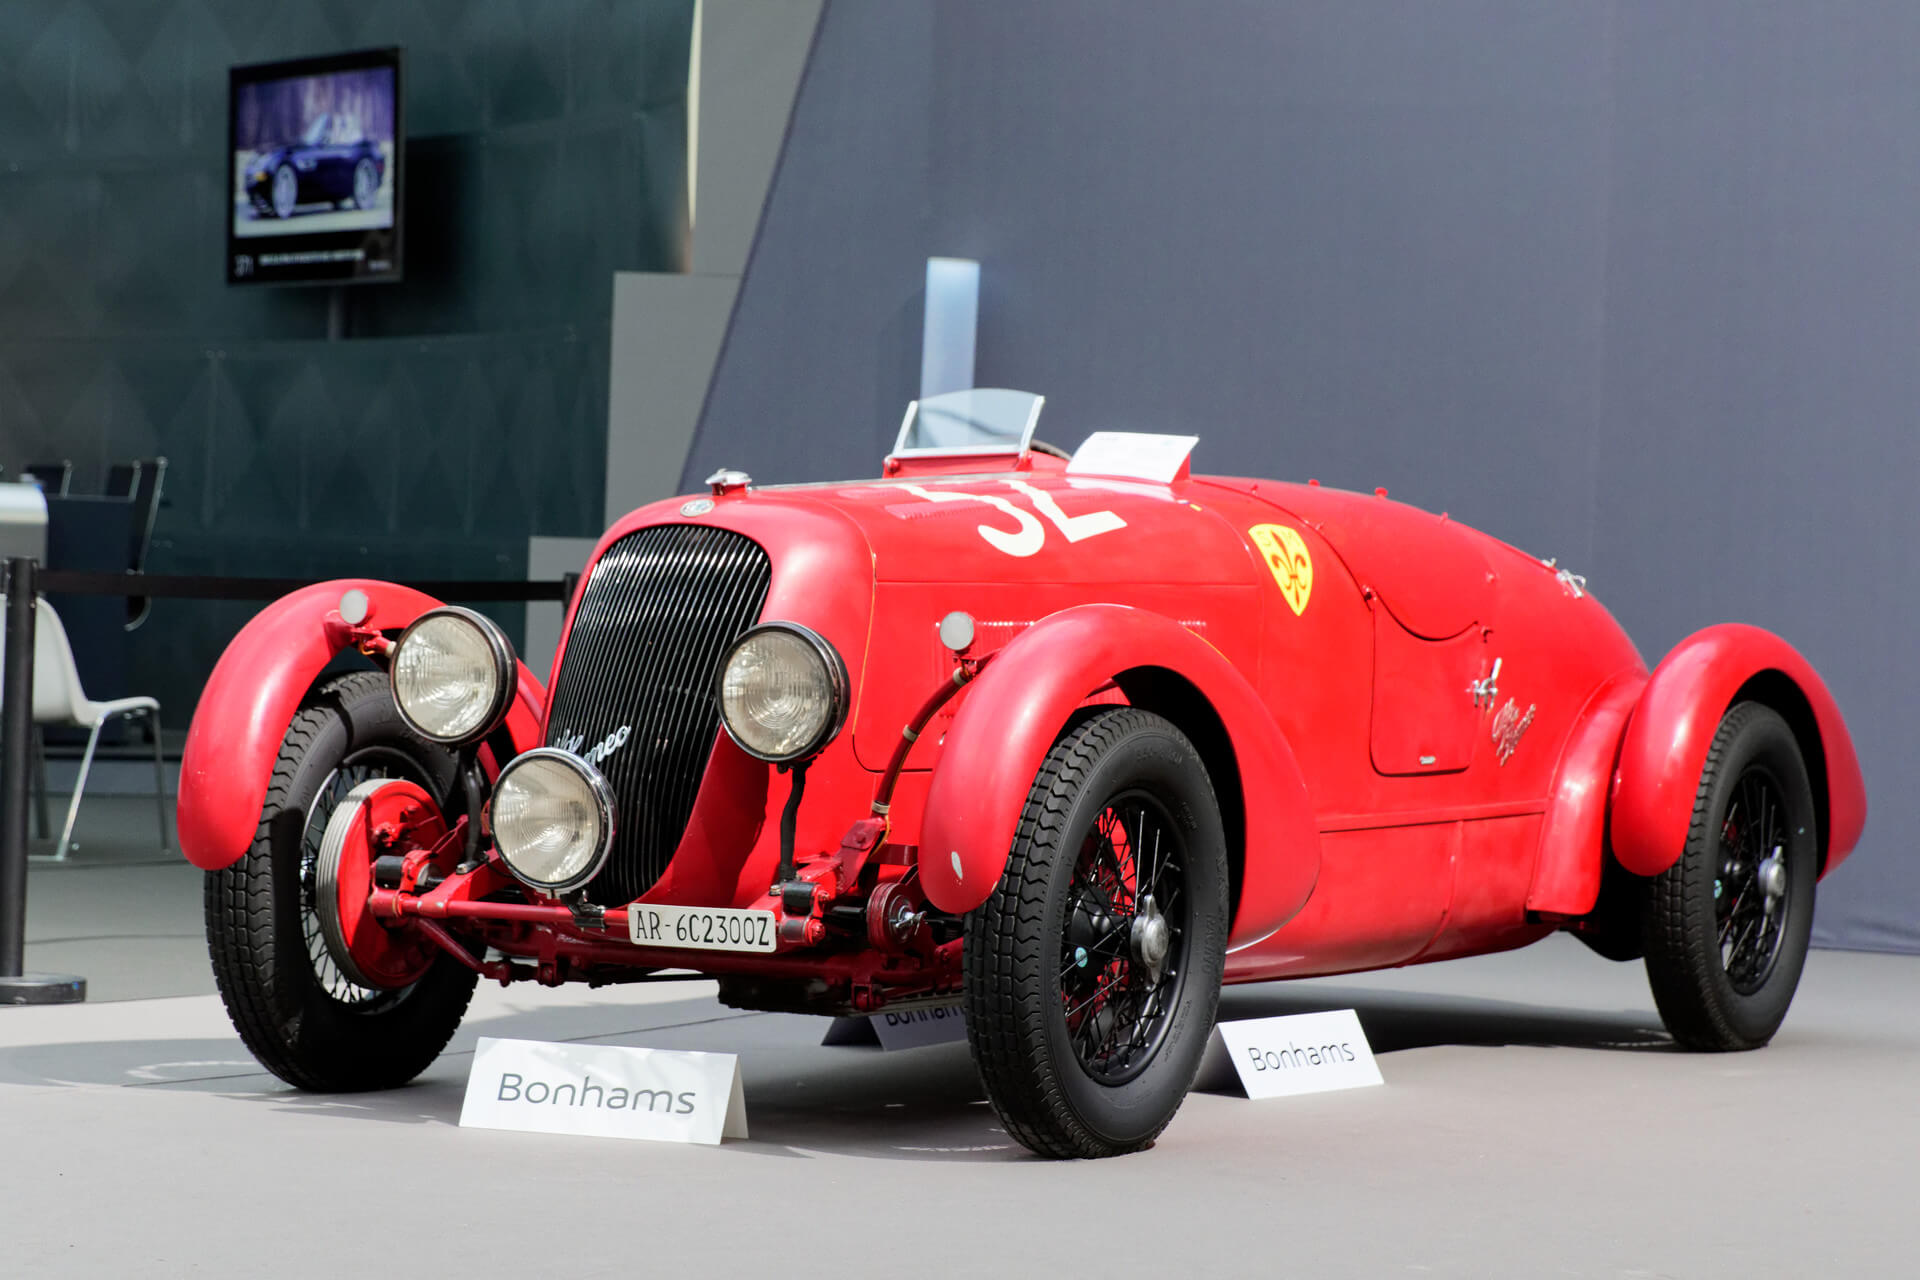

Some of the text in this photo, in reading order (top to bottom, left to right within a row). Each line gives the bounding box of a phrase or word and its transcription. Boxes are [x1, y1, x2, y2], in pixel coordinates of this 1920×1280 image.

[583, 725, 632, 763] meo
[1248, 1041, 1356, 1072] Bonhams
[497, 1072, 696, 1115] Bonhams
